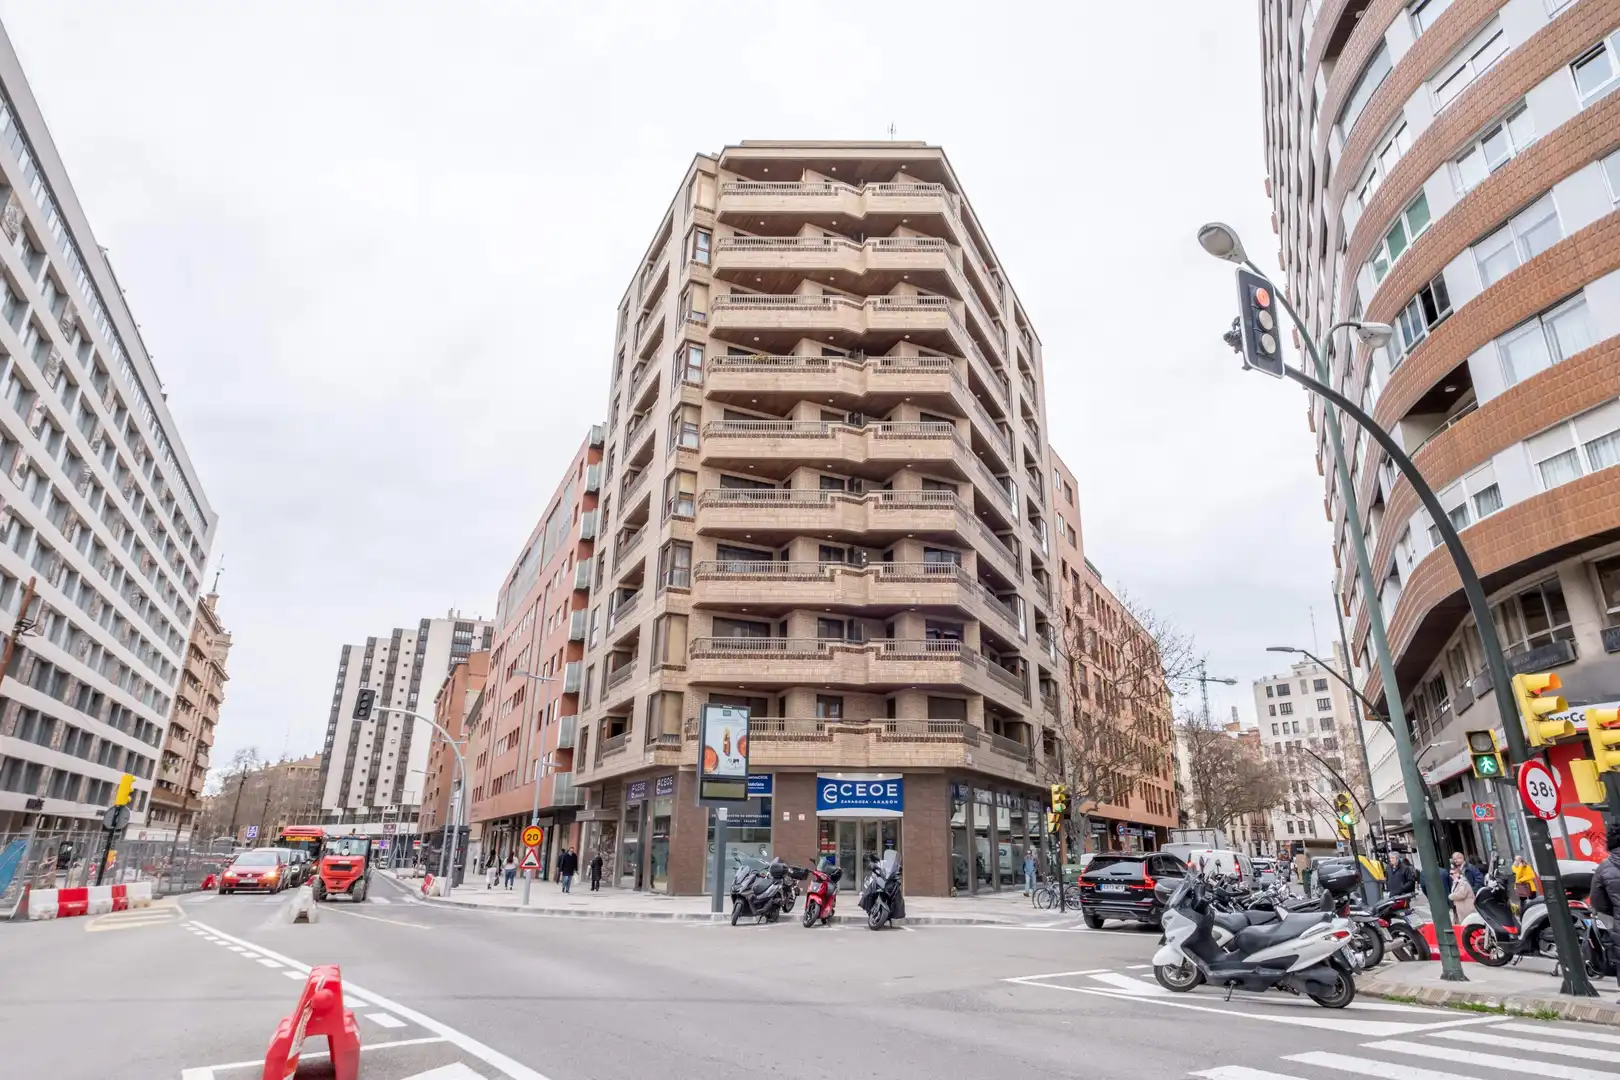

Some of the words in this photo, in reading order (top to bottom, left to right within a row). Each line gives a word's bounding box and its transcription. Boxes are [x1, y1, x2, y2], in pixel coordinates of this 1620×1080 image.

[840, 783, 898, 797] CEOE
[1529, 781, 1554, 797] 38t
[526, 833, 539, 841] 20
